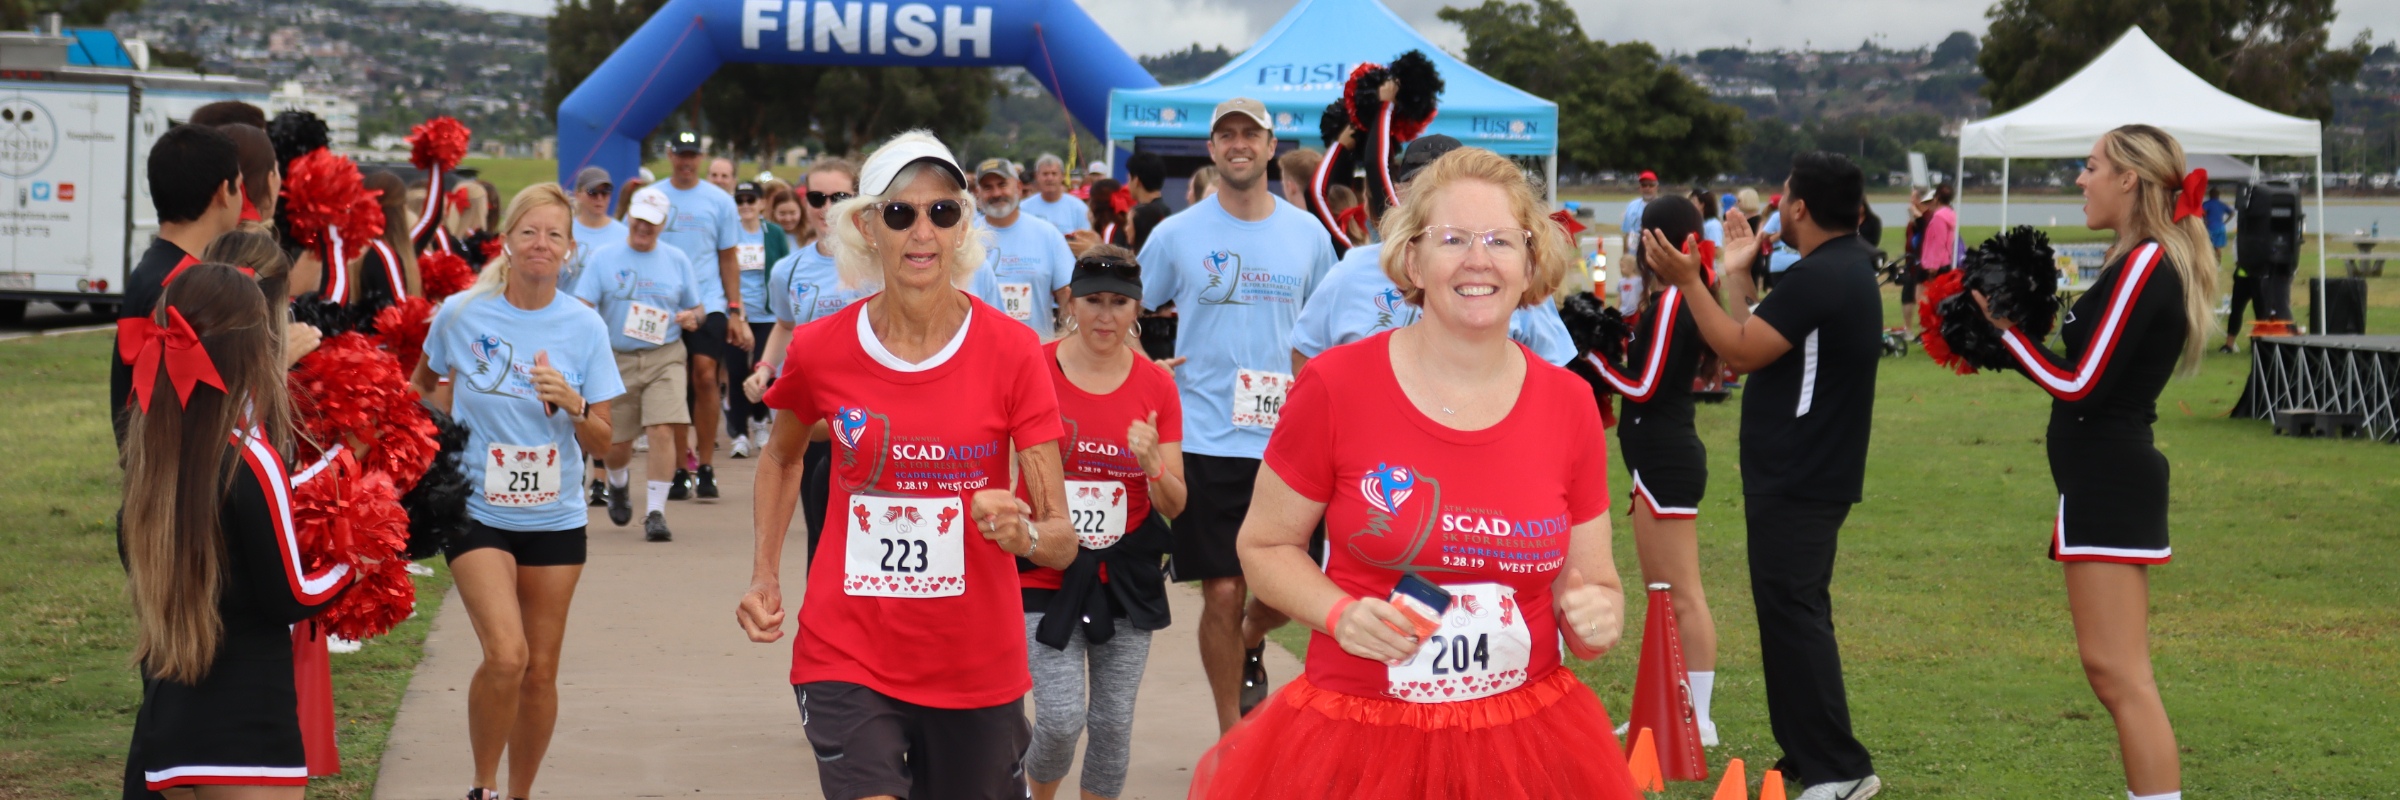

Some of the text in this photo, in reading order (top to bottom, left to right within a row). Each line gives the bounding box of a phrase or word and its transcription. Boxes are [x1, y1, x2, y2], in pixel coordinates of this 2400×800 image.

[742, 0, 993, 58] FINISH
[1258, 63, 1346, 86] FUSI
[1241, 272, 1302, 287] SCADADDLE
[639, 319, 657, 334] 159
[1254, 394, 1281, 415] 166
[892, 440, 998, 461] SCADADDLE
[894, 460, 981, 470] 5K FOR RESEARCH
[1078, 465, 1101, 473] 9.28.19
[1108, 470, 1127, 478] WEST
[509, 471, 540, 492] 251
[895, 469, 984, 480] SCADRESEARCH.ORG
[896, 481, 928, 490] 9.28.19
[937, 481, 962, 492] WEST
[1443, 504, 1505, 517] 5TH ANNUAL
[1072, 509, 1106, 534] 222
[1442, 513, 1567, 538] SCADADDLE
[1442, 533, 1557, 549] 5K FOR RESEARCH
[880, 538, 929, 573] 223
[1443, 545, 1561, 560] SCADRESEARCH.ORG
[1442, 556, 1565, 574] 9.28.19 WEST COAST
[1431, 633, 1490, 675] 204
